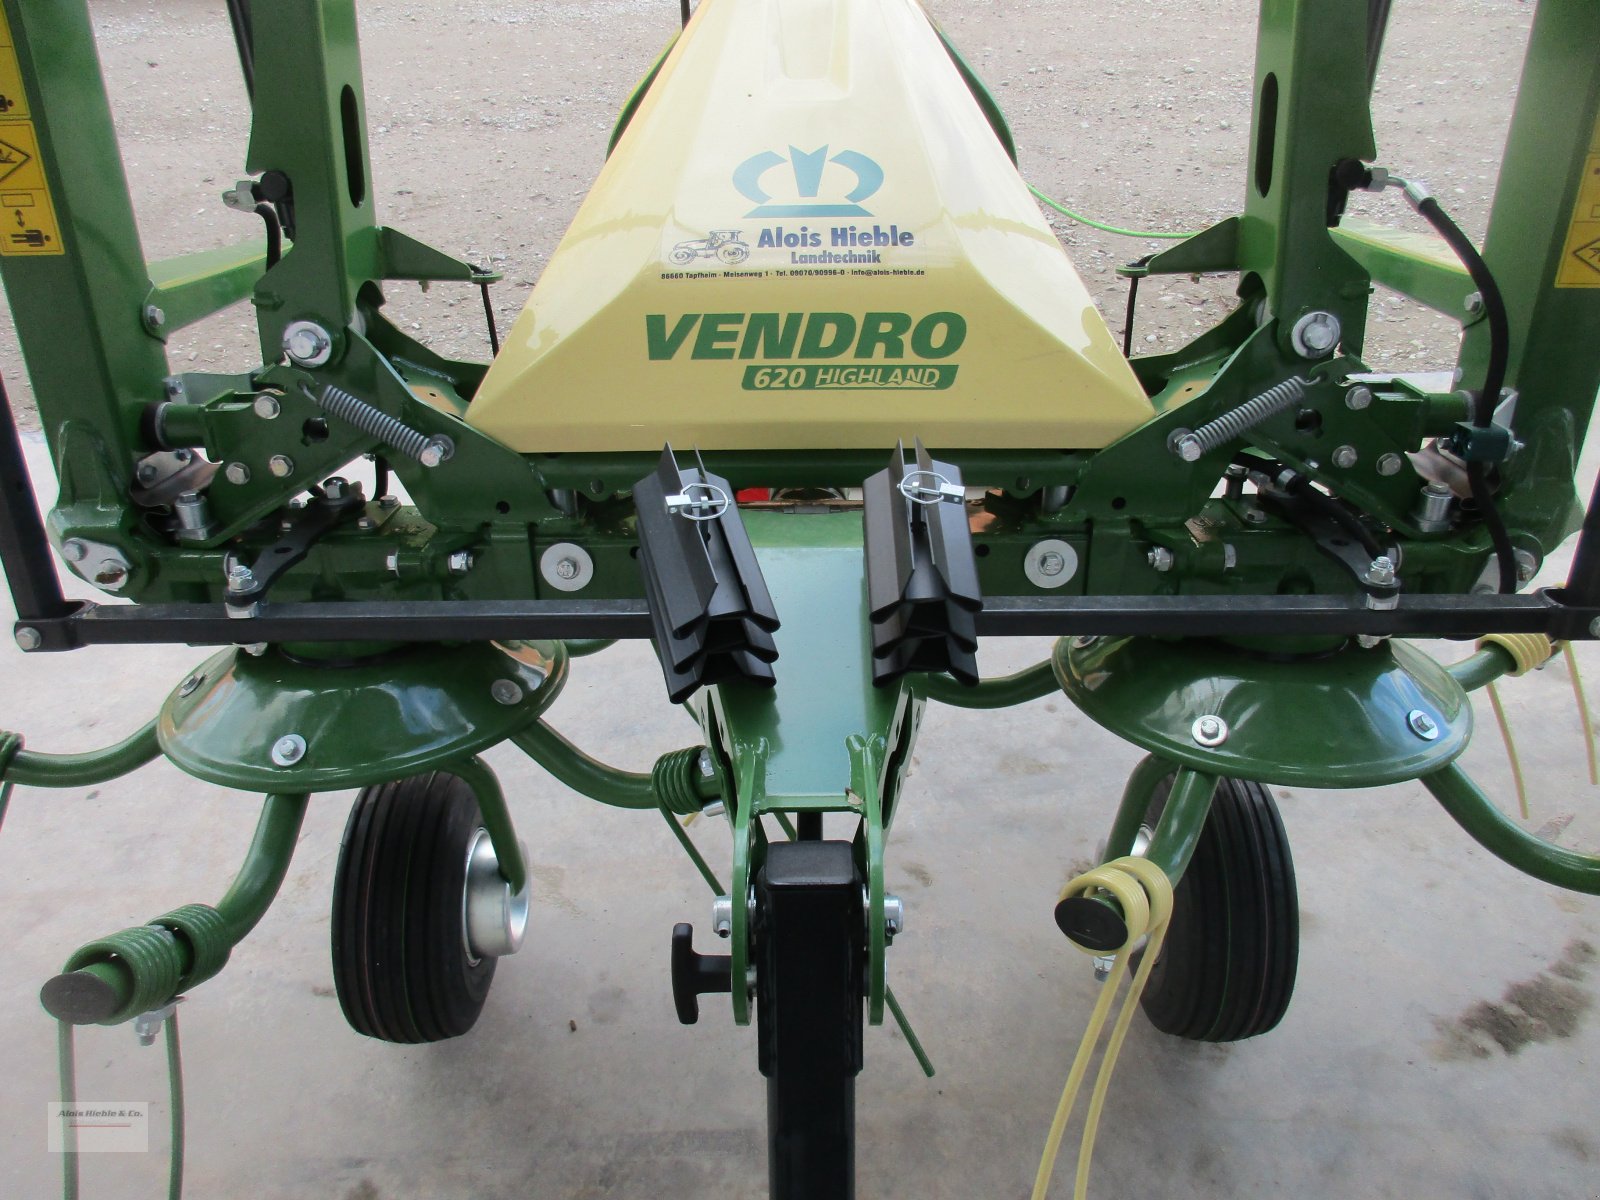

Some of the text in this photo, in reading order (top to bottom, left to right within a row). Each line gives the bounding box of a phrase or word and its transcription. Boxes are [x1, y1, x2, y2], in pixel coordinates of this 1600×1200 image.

[757, 225, 914, 248] Alois Hieble
[791, 250, 881, 264] Landtechnik
[645, 311, 967, 360] VENDRO
[754, 368, 940, 388] 620 HIGHLAND
